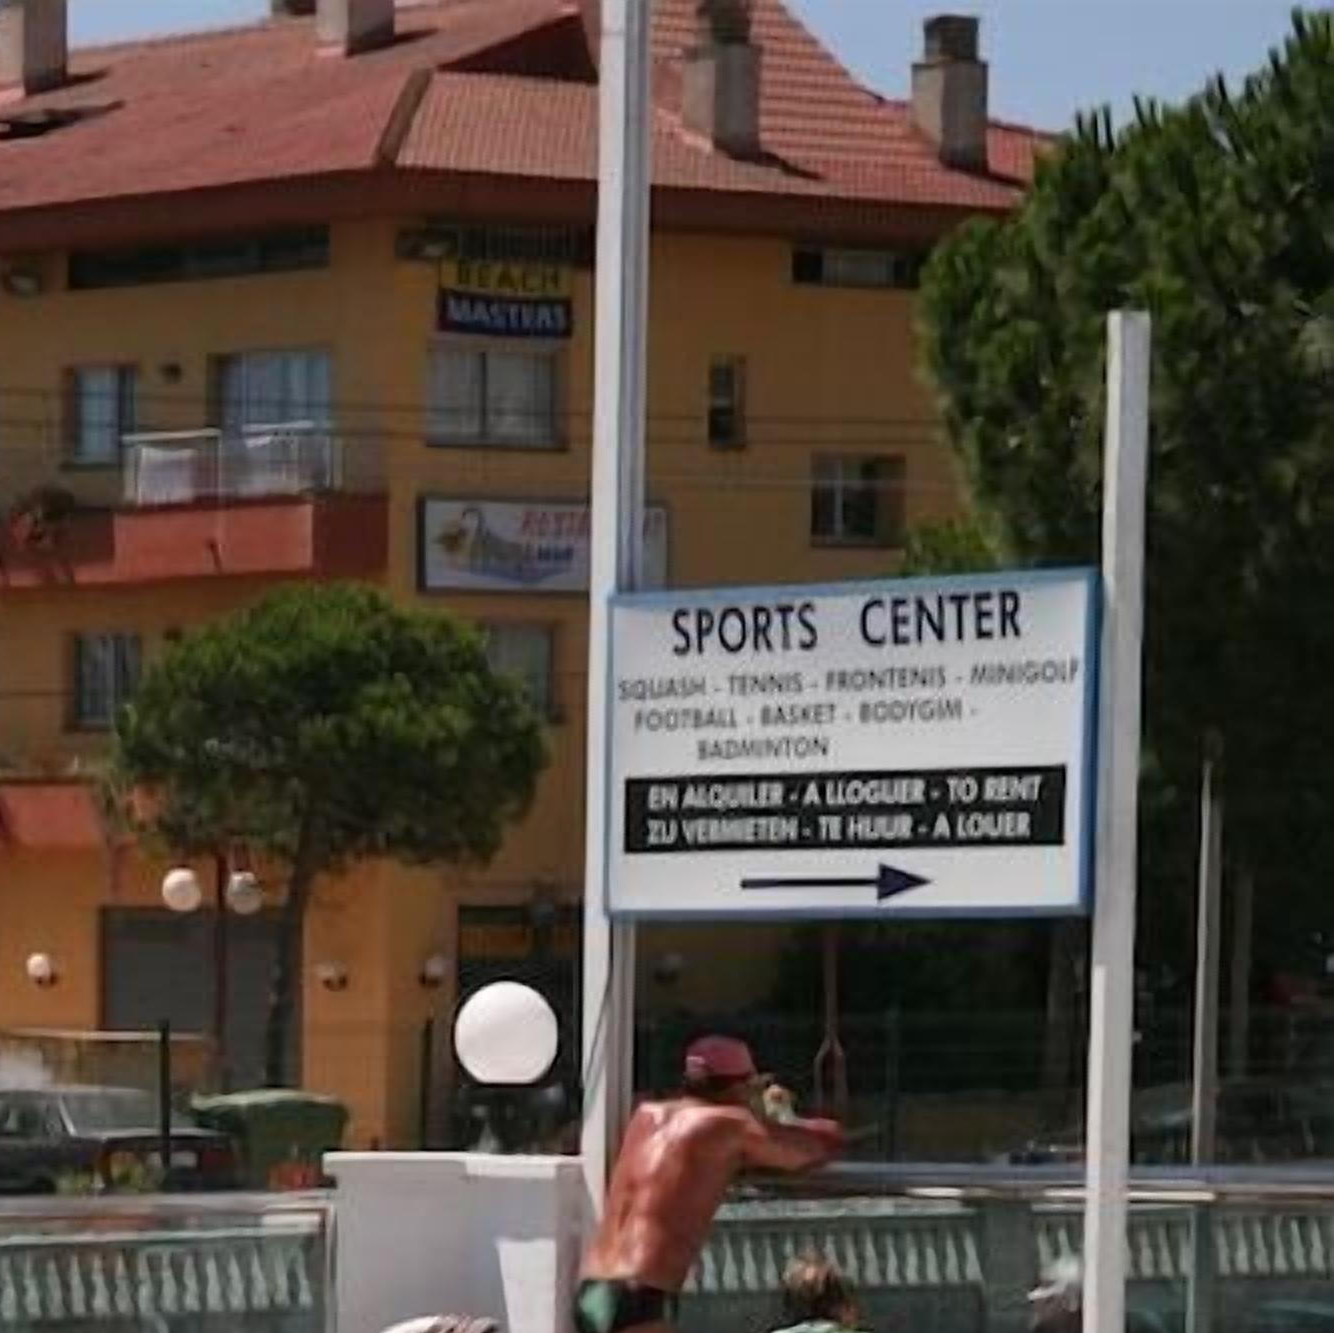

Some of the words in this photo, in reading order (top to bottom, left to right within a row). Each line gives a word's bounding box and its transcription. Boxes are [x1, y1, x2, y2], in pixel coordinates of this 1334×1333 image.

[457, 259, 560, 289] BEACH
[672, 602, 819, 656] SPORTS
[860, 590, 1022, 647] CENTER
[619, 677, 707, 701] SQUASH
[727, 671, 804, 696] TENNIS
[826, 664, 946, 692] FRONTENIS
[970, 657, 1079, 686] MINIGOLF
[634, 706, 738, 733] FOOTBALL
[759, 702, 837, 727] BASKET
[697, 735, 829, 762] BADMINTON
[648, 783, 679, 810] EN
[681, 780, 784, 809] ALQUILER
[803, 780, 821, 805] A
[825, 777, 926, 805] LLOGUER
[947, 776, 979, 803] TO
[983, 774, 1043, 802] RENT
[647, 818, 679, 845] ZU
[681, 815, 799, 844] VERMIETEN
[818, 815, 843, 841] TE
[848, 813, 913, 840] HUUR
[933, 811, 951, 838] A
[957, 810, 1031, 838] LOUER
